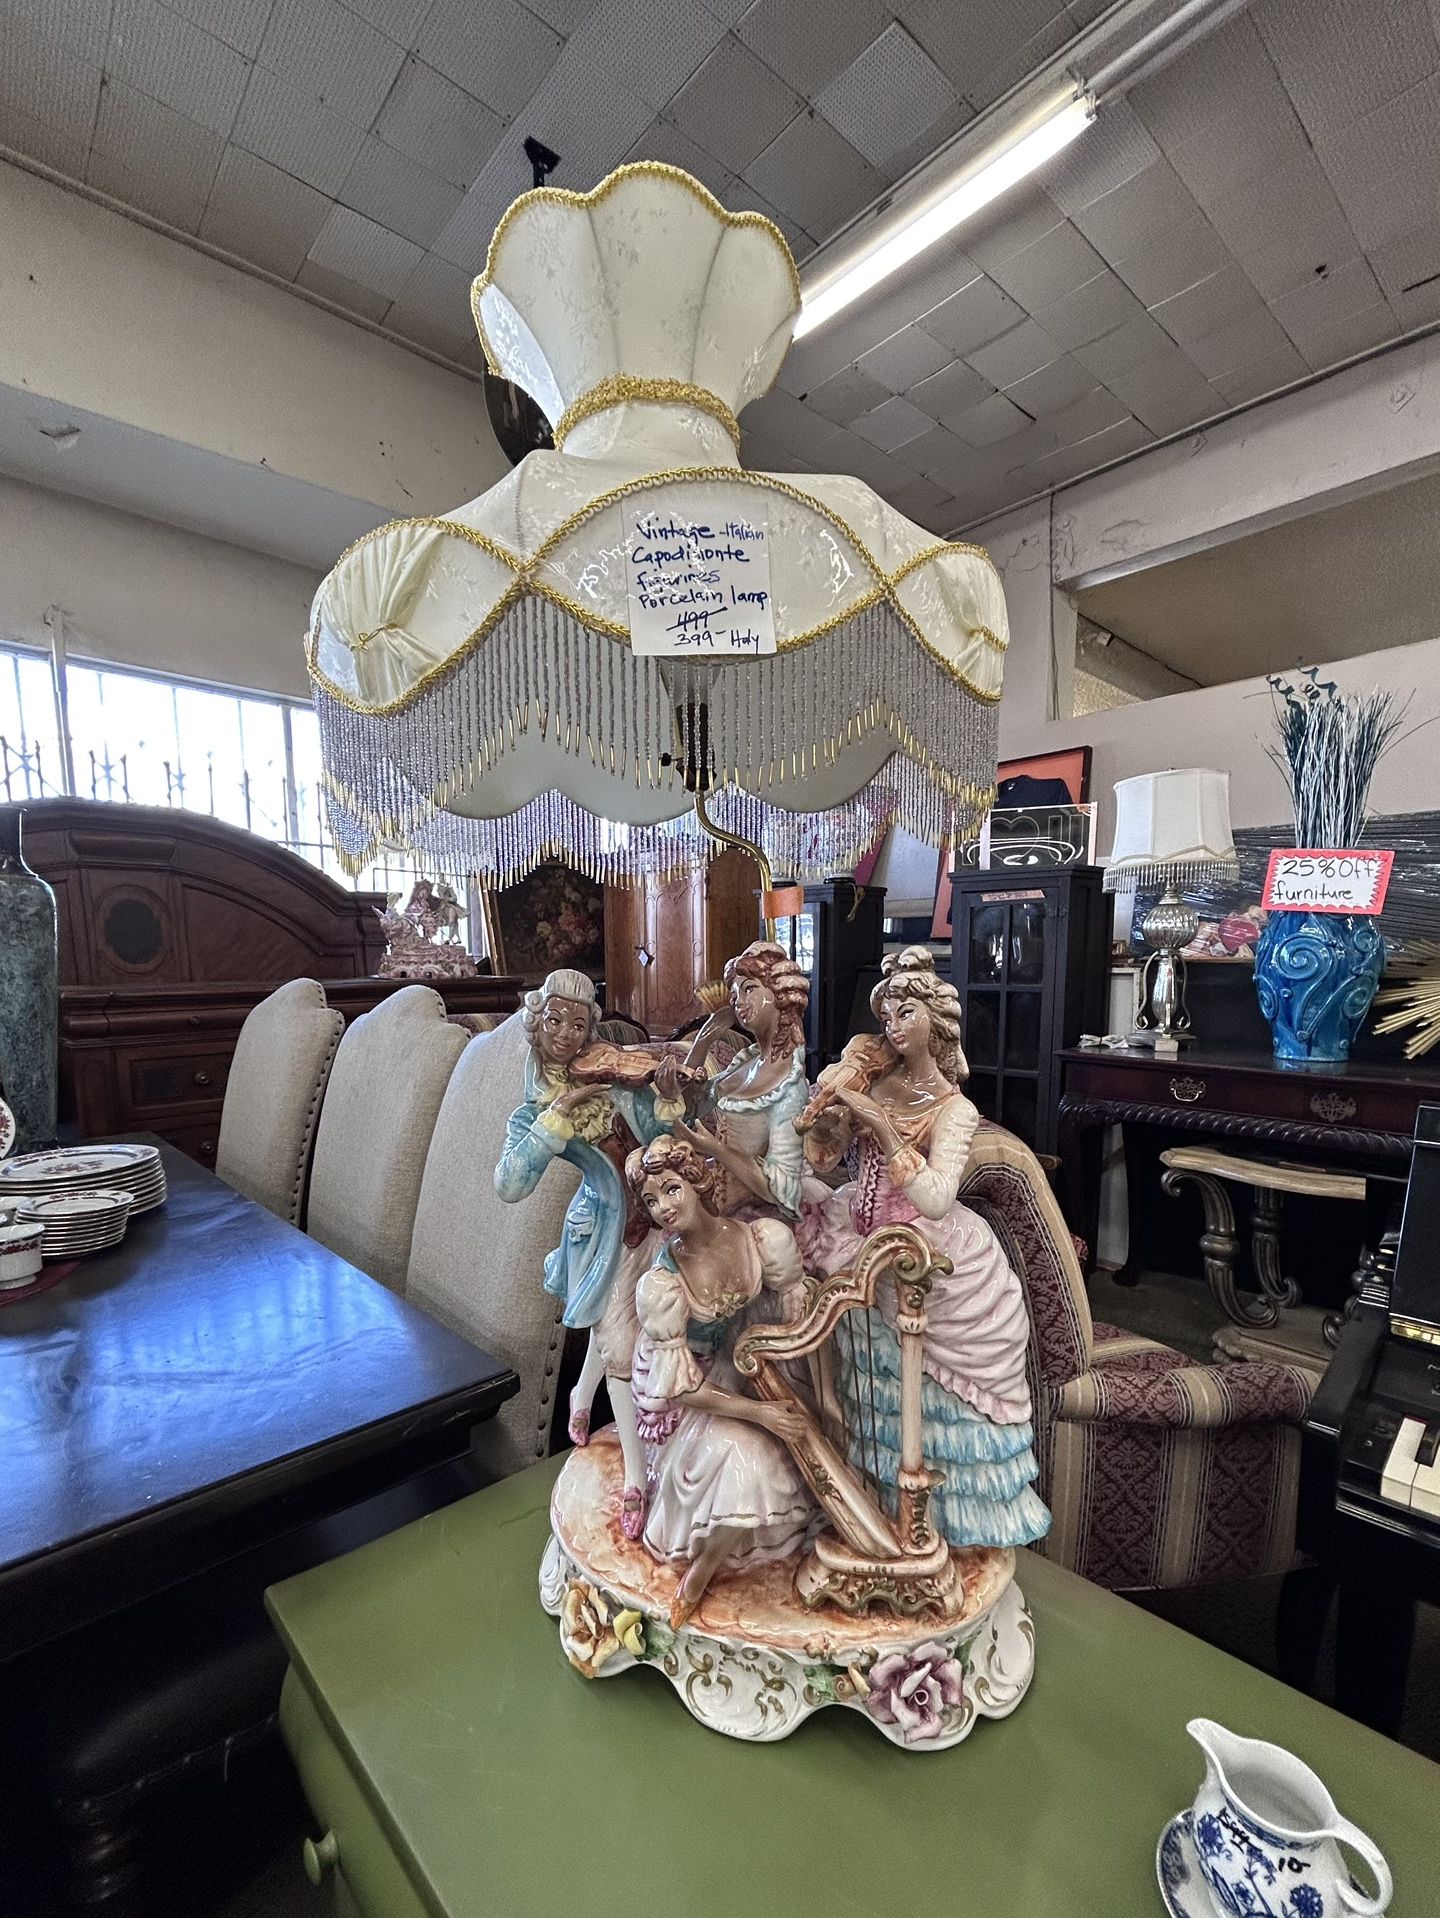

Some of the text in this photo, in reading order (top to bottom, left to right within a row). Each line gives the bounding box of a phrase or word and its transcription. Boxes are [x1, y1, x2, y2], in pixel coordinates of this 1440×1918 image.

[636, 517, 716, 545] Vintage
[731, 585, 768, 611] lamp
[1274, 880, 1354, 901] furniture
